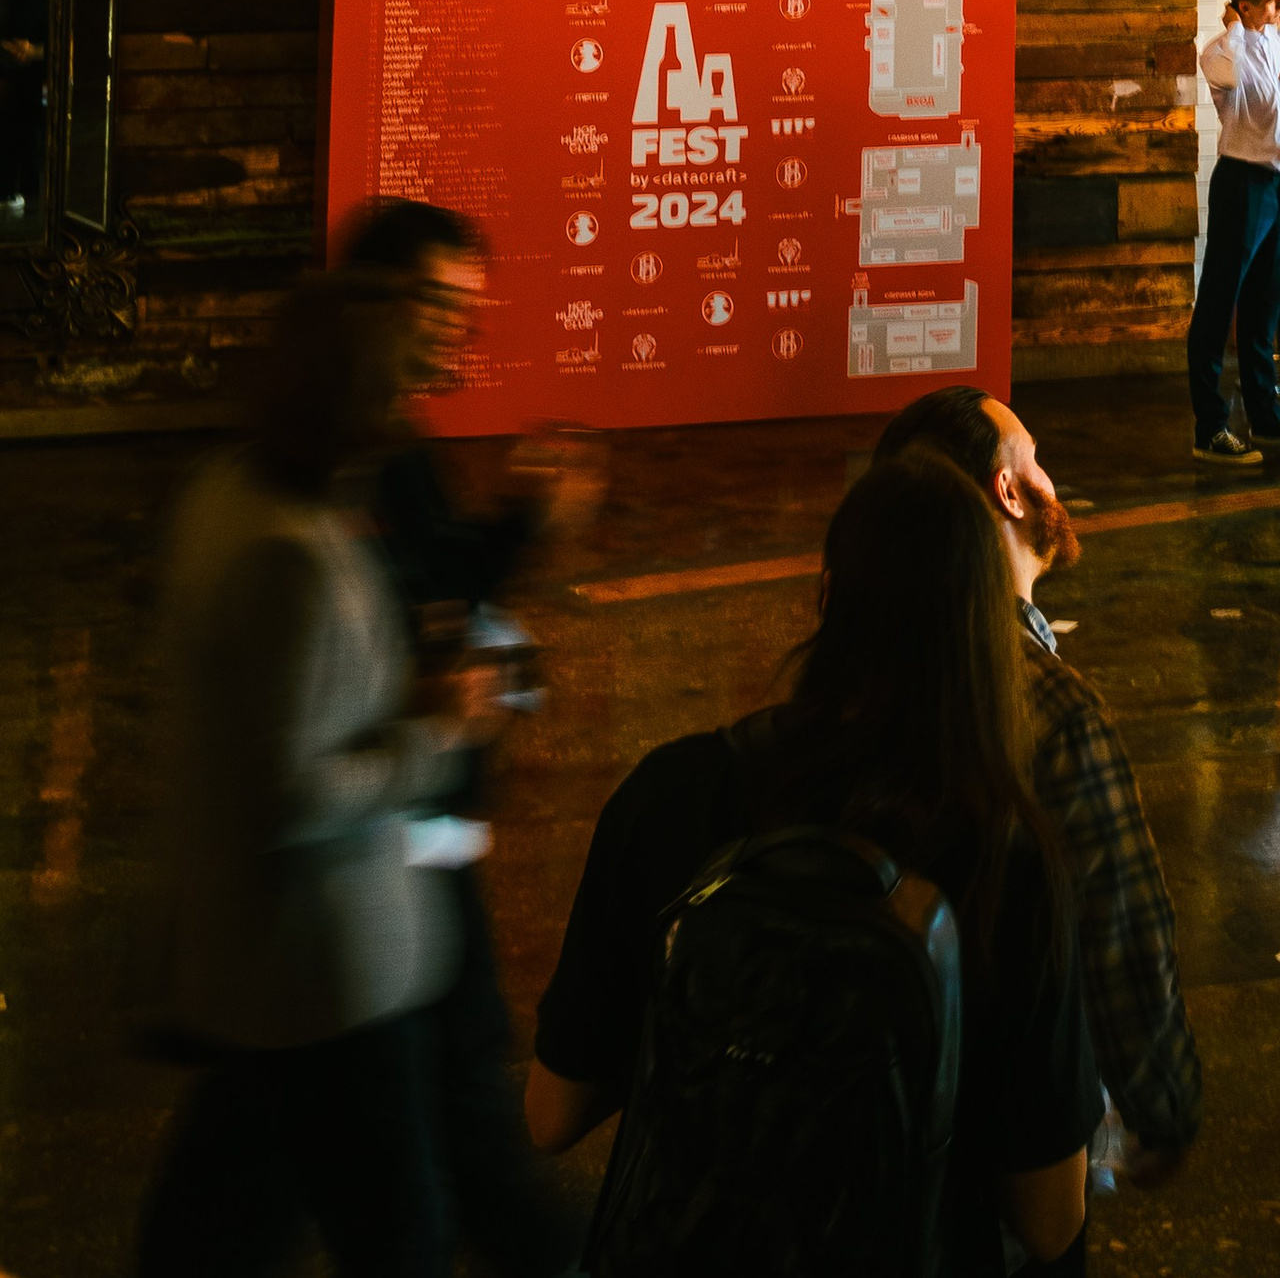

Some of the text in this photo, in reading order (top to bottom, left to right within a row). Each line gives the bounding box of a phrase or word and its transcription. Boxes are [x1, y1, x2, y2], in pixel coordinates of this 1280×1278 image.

[906, 95, 935, 109] ВХОД
[631, 125, 749, 167] FEST
[630, 170, 650, 190] by
[630, 190, 747, 230] 2024
